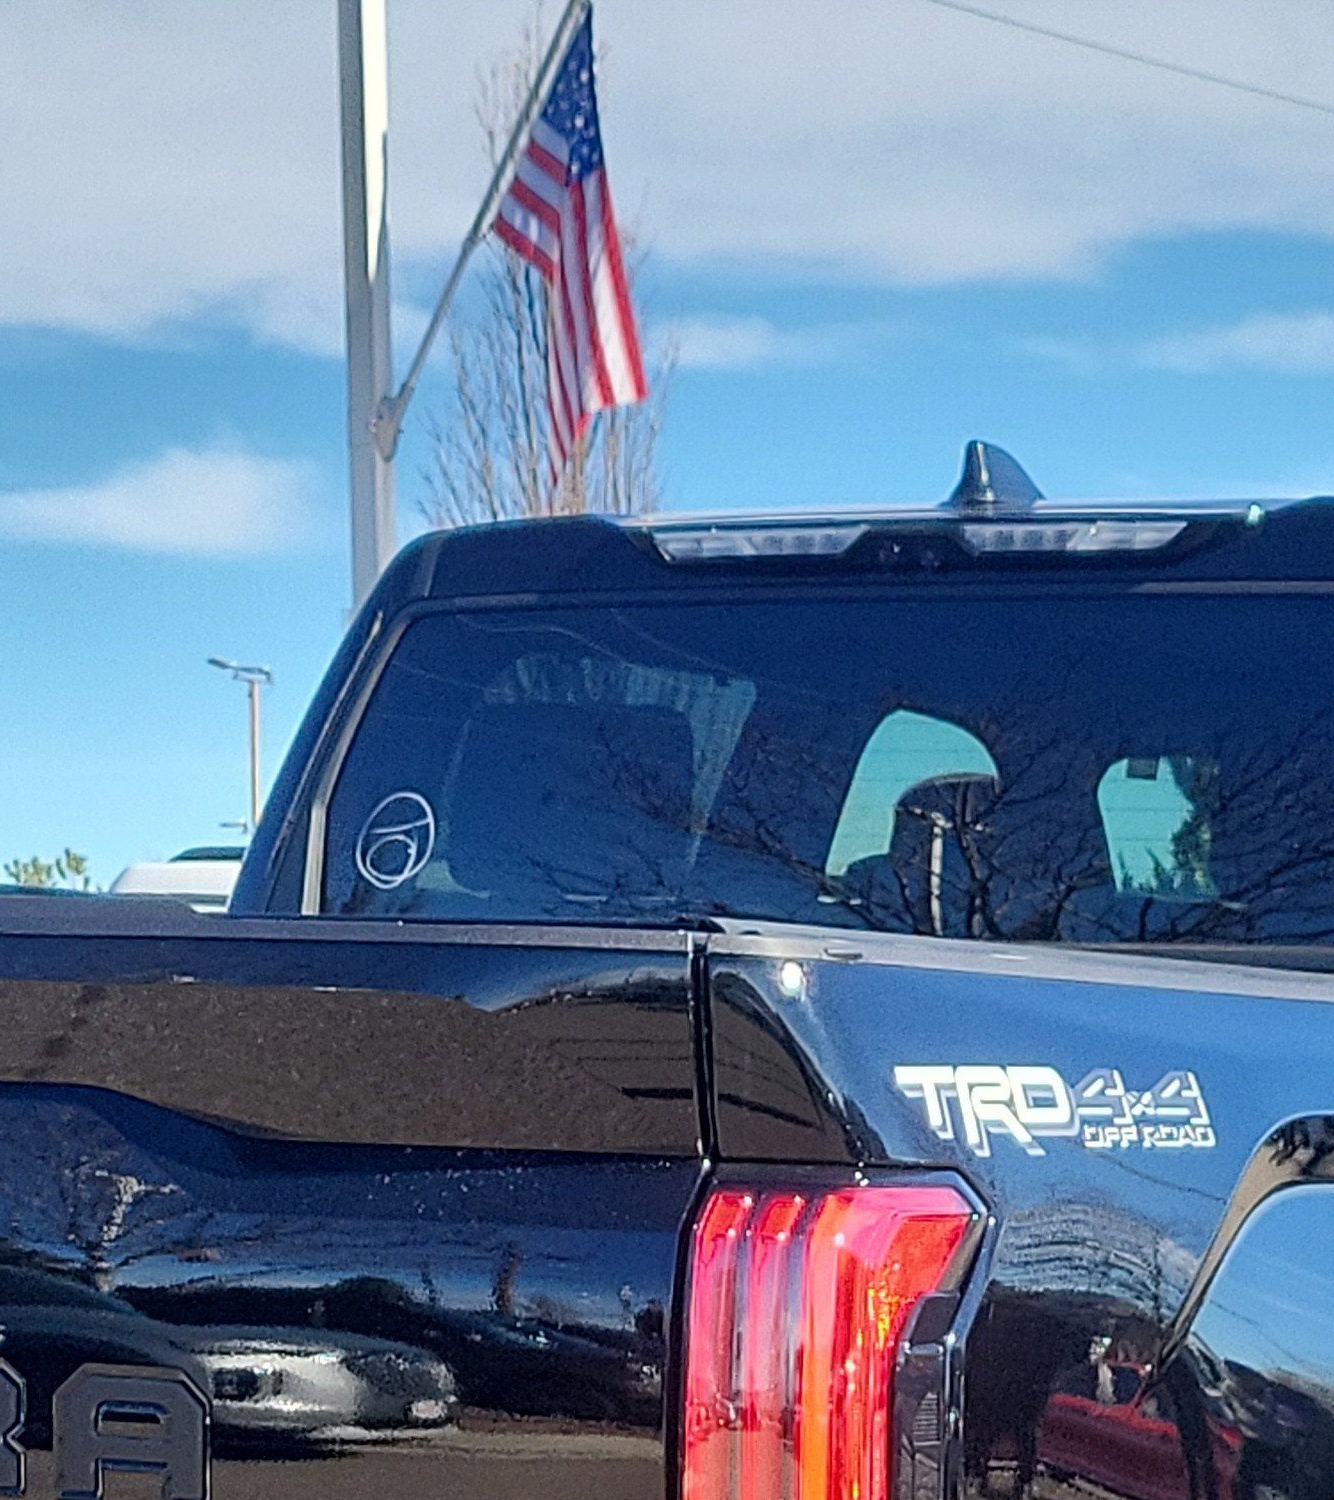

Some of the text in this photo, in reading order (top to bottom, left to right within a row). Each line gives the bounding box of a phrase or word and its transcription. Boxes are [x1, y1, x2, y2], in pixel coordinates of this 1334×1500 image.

[893, 1063, 1080, 1158] TRD
[1084, 1124, 1216, 1149] OFF ROAD
